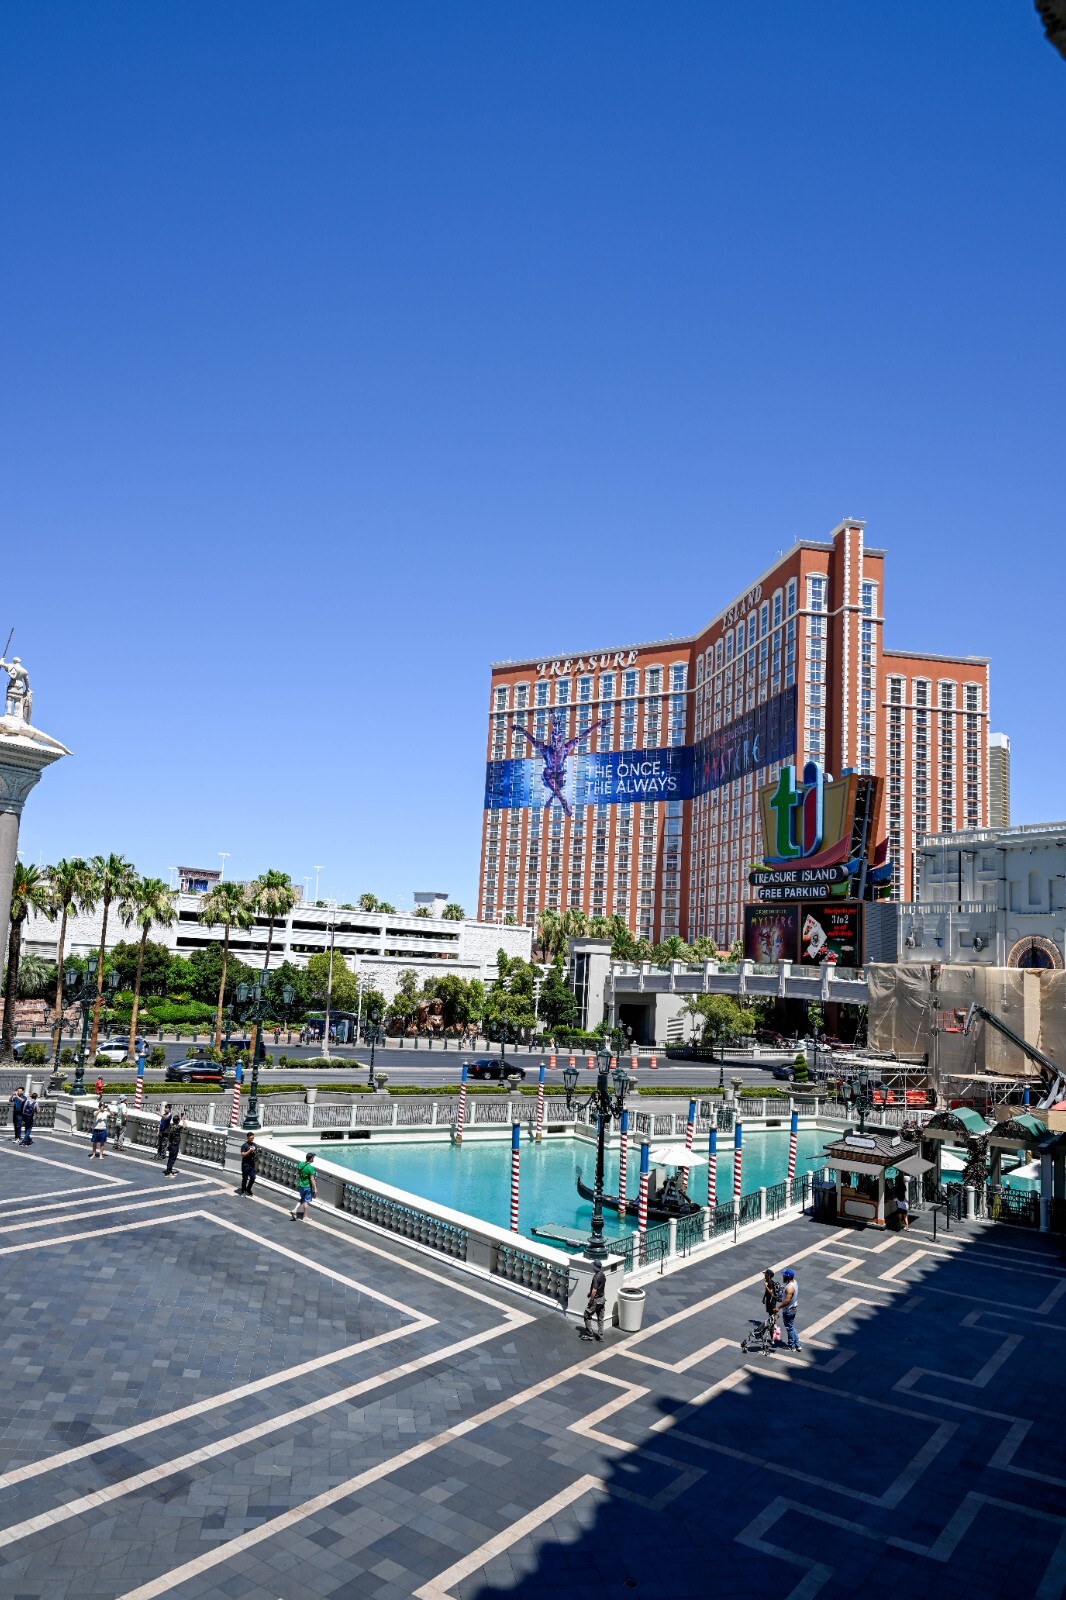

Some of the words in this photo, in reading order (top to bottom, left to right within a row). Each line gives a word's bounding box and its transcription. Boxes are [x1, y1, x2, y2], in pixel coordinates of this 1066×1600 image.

[536, 650, 639, 676] TREASURE
[721, 584, 763, 632] ISLAND
[586, 764, 613, 779] THE
[617, 760, 665, 778] ONCE,
[586, 780, 612, 795] THE
[616, 776, 677, 794] ALWAYS
[754, 870, 797, 884] TREASURE
[801, 868, 837, 882] ISLAND
[760, 888, 782, 899] FREE
[784, 886, 827, 898] PARKING
[831, 914, 836, 924] 3
[844, 914, 849, 924] 2
